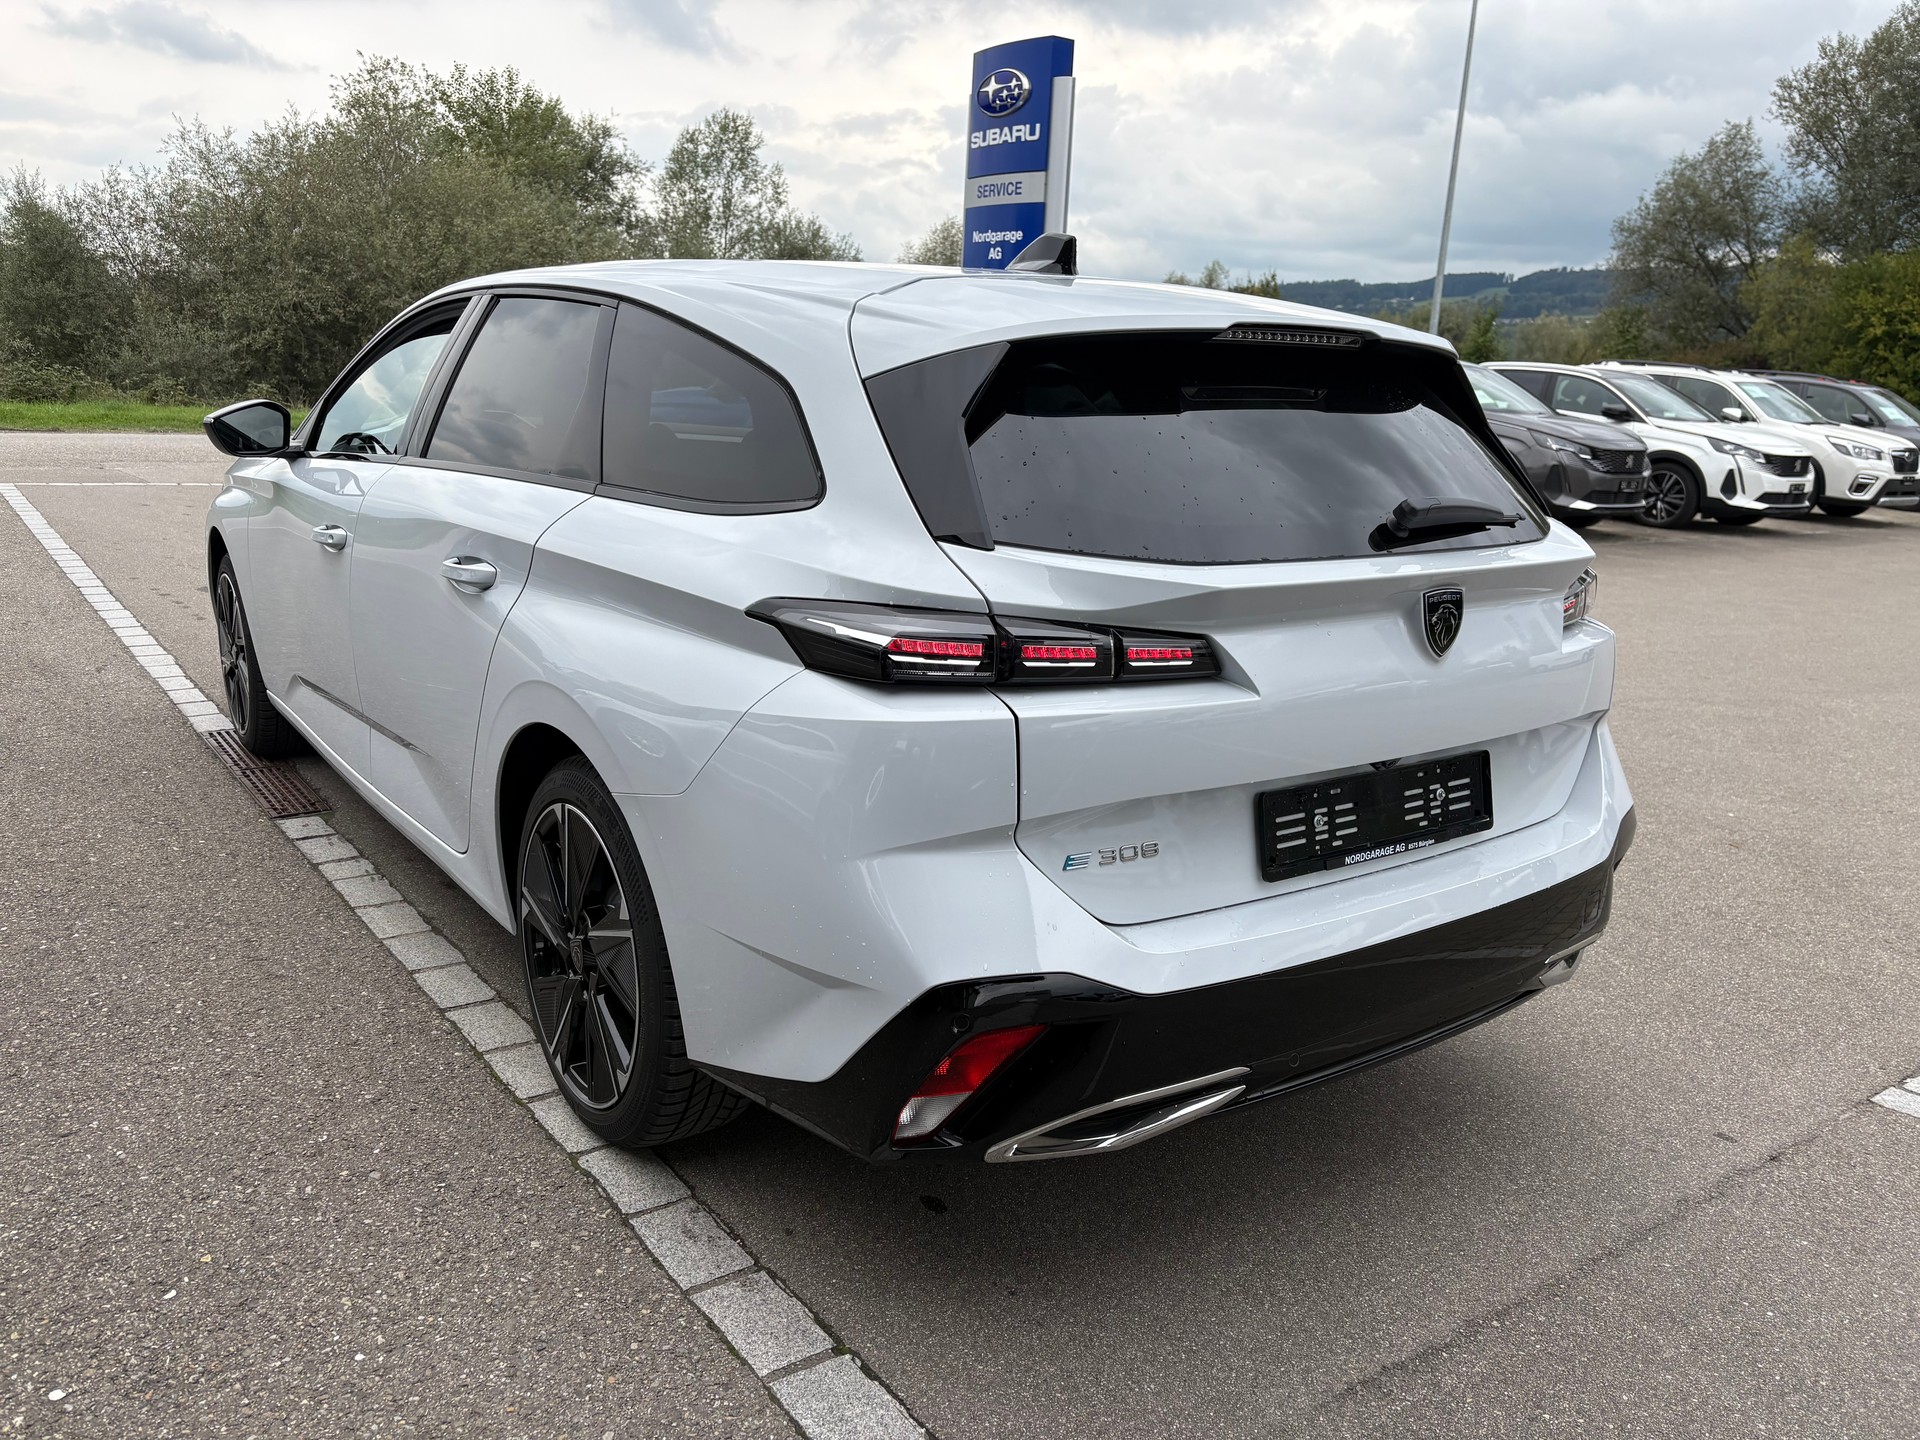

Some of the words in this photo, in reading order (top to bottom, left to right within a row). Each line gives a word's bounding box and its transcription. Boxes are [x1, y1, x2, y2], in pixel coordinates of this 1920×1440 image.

[970, 123, 1041, 149] SUBARU
[976, 181, 1023, 199] SERVICE
[972, 229, 1024, 244] Nordgarage
[988, 247, 1002, 260] AG
[1428, 594, 1461, 604] PEUGEOT
[1062, 851, 1093, 871] E
[1098, 840, 1160, 867] 308
[1344, 845, 1395, 865] NORDGARAGE
[1395, 843, 1406, 853] AG
[1408, 841, 1418, 850] 8575
